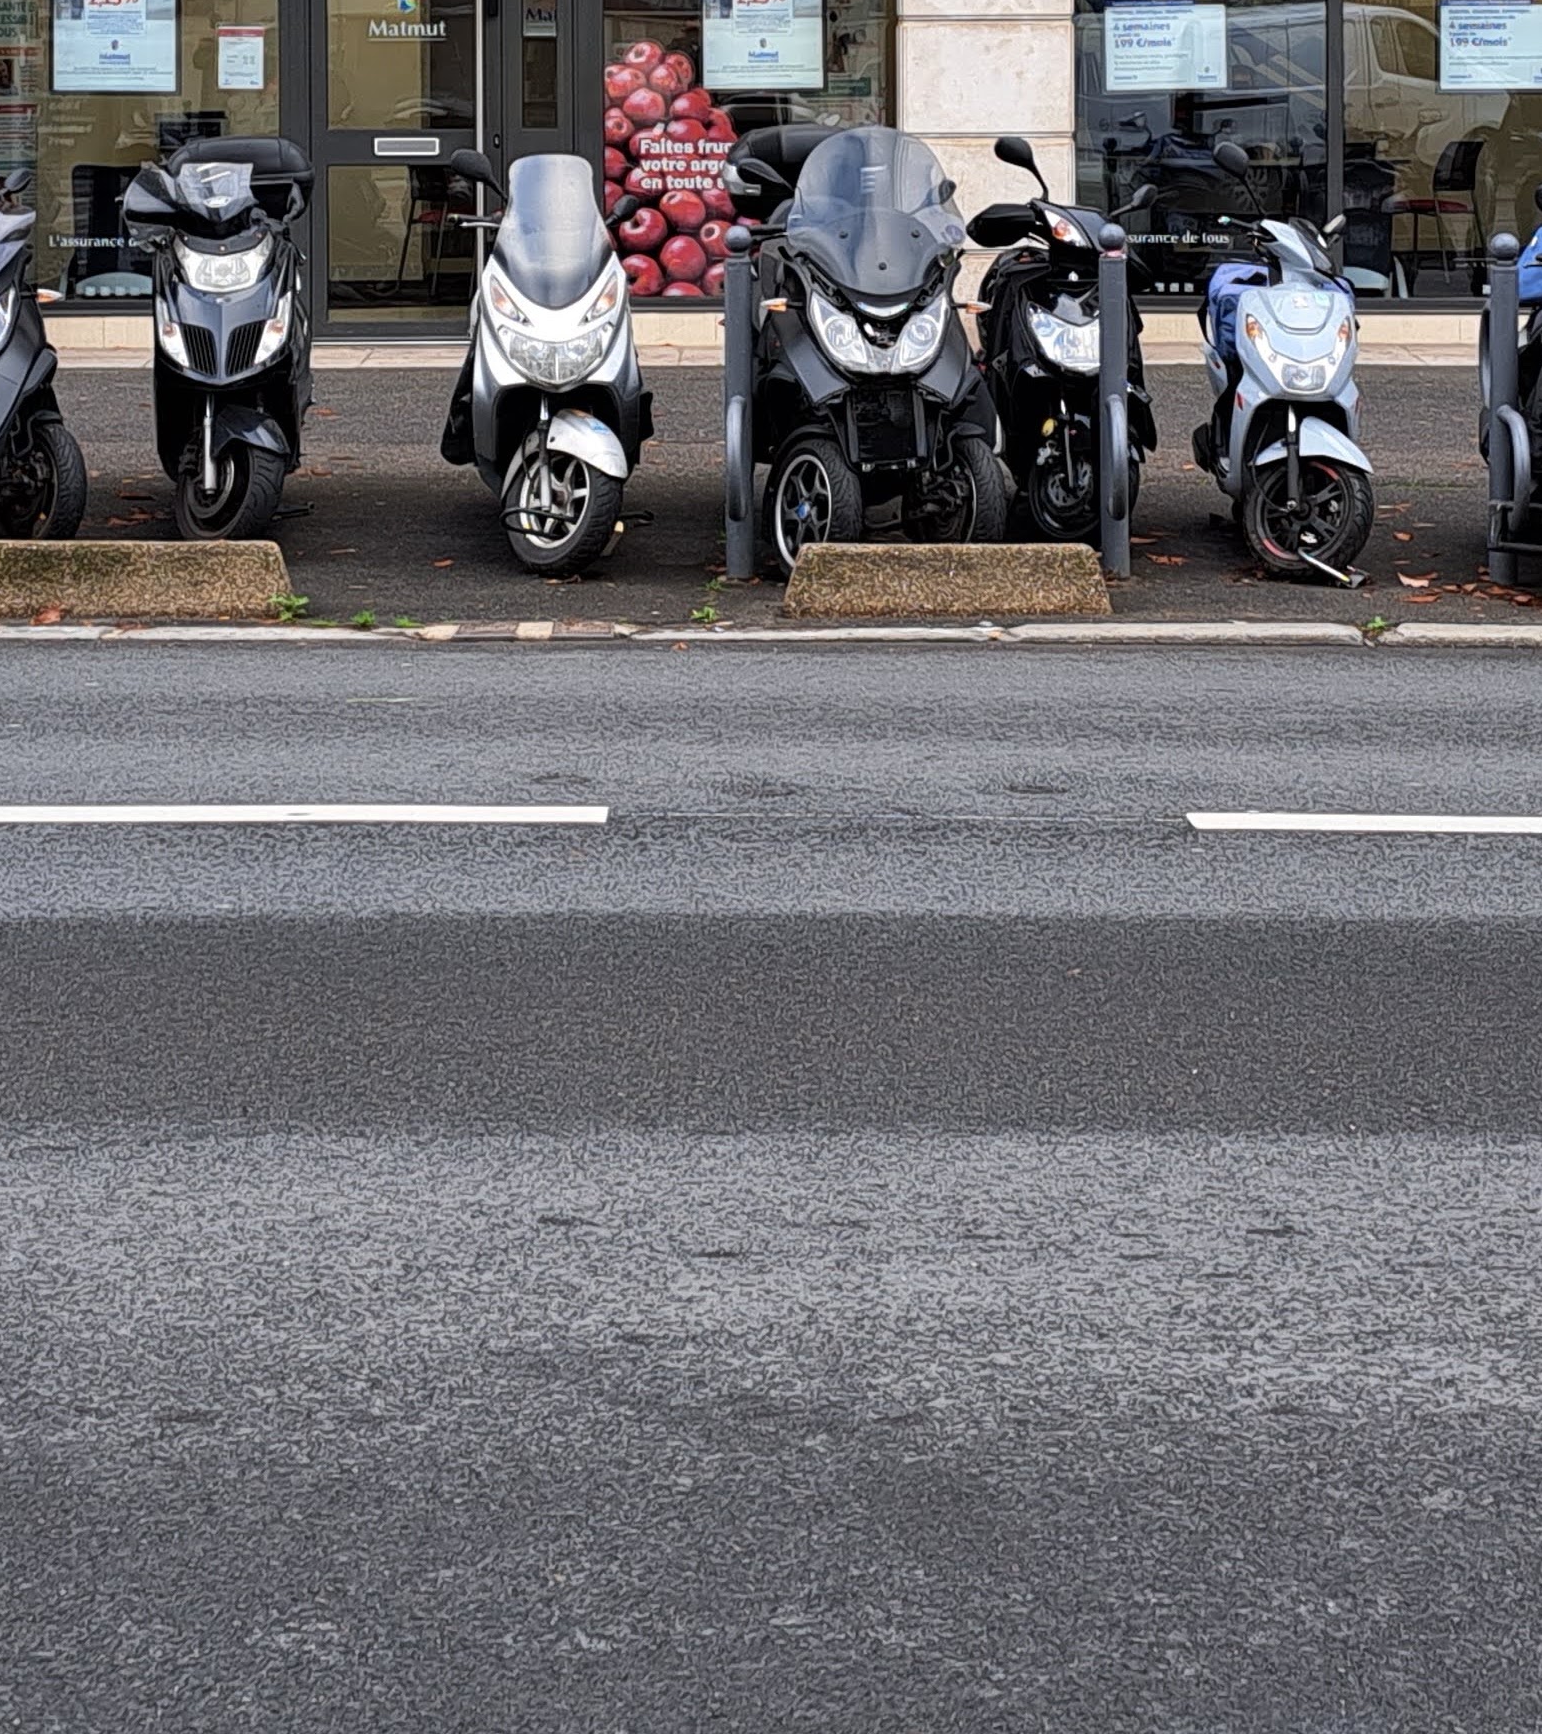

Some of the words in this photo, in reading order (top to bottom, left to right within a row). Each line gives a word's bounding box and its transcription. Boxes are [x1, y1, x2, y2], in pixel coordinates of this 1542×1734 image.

[368, 19, 447, 36] Matmut
[640, 137, 695, 154] Faites
[641, 157, 687, 172] votre
[641, 177, 662, 190] en
[666, 175, 714, 190] toute
[48, 234, 124, 248] L'assurance
[1182, 230, 1199, 244] de
[1202, 231, 1230, 244] tous
